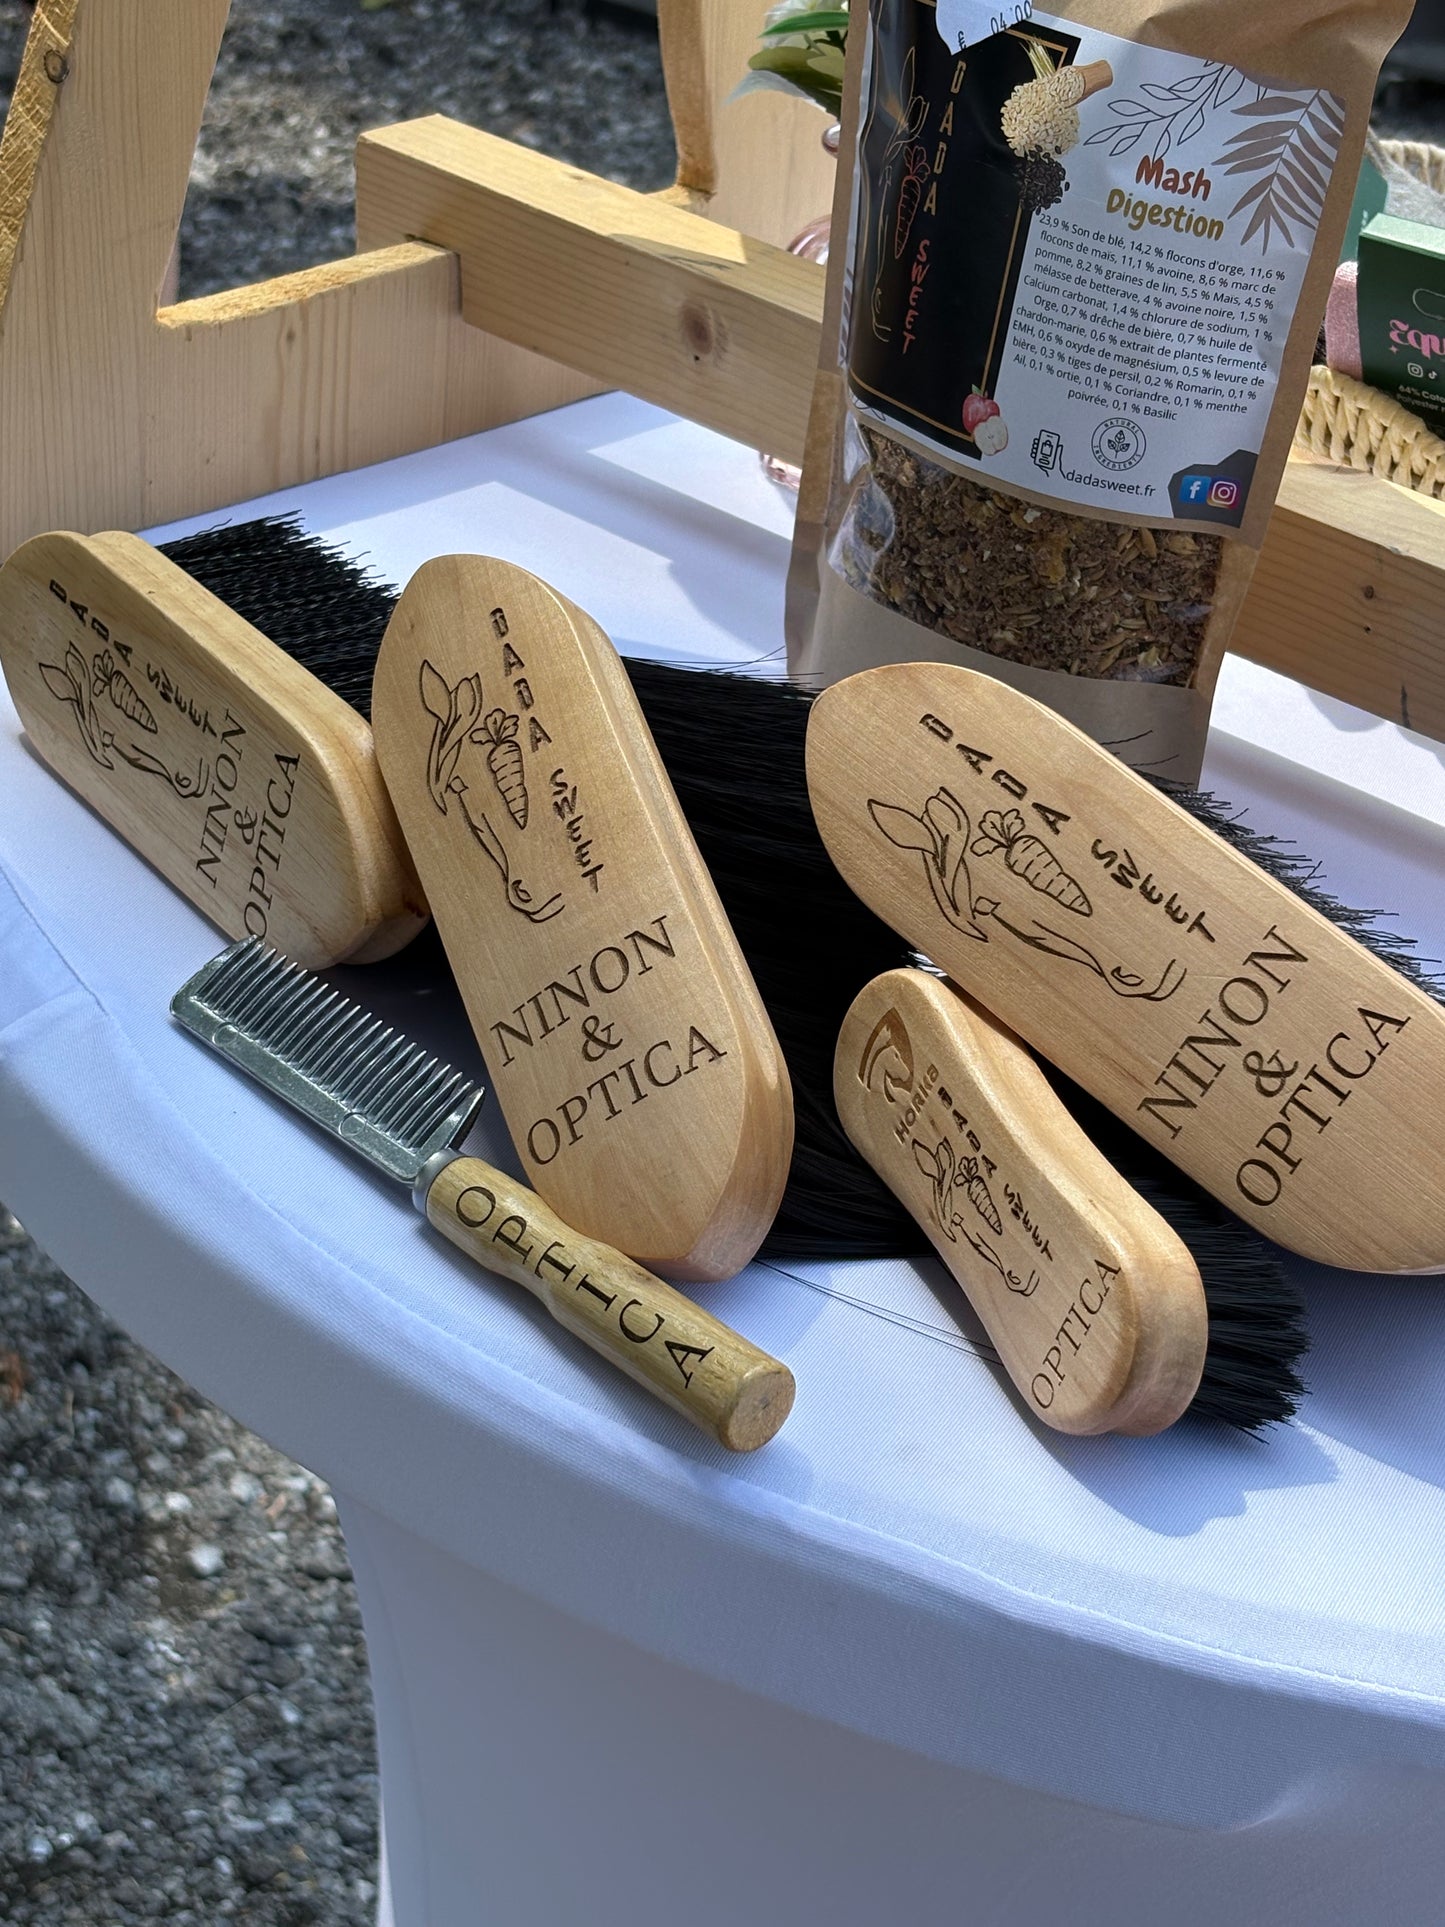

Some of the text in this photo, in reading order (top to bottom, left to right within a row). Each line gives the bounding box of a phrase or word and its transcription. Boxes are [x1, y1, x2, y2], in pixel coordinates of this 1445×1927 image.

[902, 60, 967, 354] DADA SWEET
[1135, 154, 1212, 201] Mash
[1038, 212, 1286, 282] 23,9 % Son de blé, 14,2 % flocons d'orge, 11,6 %
[1106, 188, 1225, 241] Digestion
[1033, 263, 1269, 325] mélasse de betterave, 4 % avoine noire, 1,5 %
[1034, 247, 1074, 269] pomme,
[1075, 258, 1093, 273] 8,2
[1093, 263, 1104, 276] %
[1103, 268, 1144, 287] graines
[1145, 278, 1160, 292] de
[1161, 281, 1178, 297] lin,
[1180, 286, 1199, 300] 5,5
[1200, 289, 1211, 301] %
[1243, 296, 1262, 308] 4,5
[1263, 298, 1274, 310] %
[1039, 229, 1075, 250] flocons
[1075, 241, 1090, 255] de
[1121, 254, 1143, 270] 11,1
[1144, 260, 1155, 273] %
[1156, 266, 1196, 285] avoine,
[1198, 273, 1217, 287] 8,6
[1218, 277, 1229, 289] %
[1230, 281, 1260, 293] marc
[1261, 282, 1277, 295] de
[1015, 305, 1268, 372] chardon-marie, 0,6 % extrait de plantes fermenté
[1023, 274, 1061, 296] Calcium
[1112, 302, 1128, 316] 1,4
[1129, 306, 1140, 319] %
[1140, 310, 1188, 328] chlorure
[1189, 318, 1205, 331] de
[1205, 322, 1250, 339] sodium,
[1254, 328, 1260, 339] 1
[1263, 330, 1273, 343] %
[1033, 294, 1254, 354] Orge, 0,7 % drêche de bière, 0,7 % huile de
[1012, 319, 1265, 388] EMH, 0,6 % oxyde de magnésium, 0,5 % levure de
[1012, 335, 1257, 401] bière, 0,3 % tiges de persil, 0,2 % Romarin, 0,1 %
[1012, 353, 1248, 414] Ail, 0,1 % ortie, 0,1 % Coriandre, 0,1 % menthe
[1067, 389, 1178, 421] poivrée, 0,1 % Basilic
[1104, 419, 1140, 434] NATURAL
[1066, 469, 1156, 497] dadasweet.fr
[1093, 445, 1141, 469] INGREDIENTS
[49, 579, 219, 738] DADA SWEET
[490, 607, 604, 892] DADA SWEET
[196, 708, 249, 889] NINON
[234, 806, 259, 846] &
[919, 713, 1217, 943] DADA SWEET
[244, 751, 300, 941] OPTICA
[490, 915, 677, 1067] NINON
[581, 1015, 623, 1062] &
[1137, 925, 1310, 1140] NINON
[526, 1025, 728, 1166] OPTICA
[1236, 1004, 1412, 1207] OPTICA
[1243, 1048, 1299, 1098] &
[938, 1086, 1054, 1262] DADA SWEET
[455, 1185, 715, 1389] OPTICA
[1030, 1257, 1123, 1410] OPTICA
